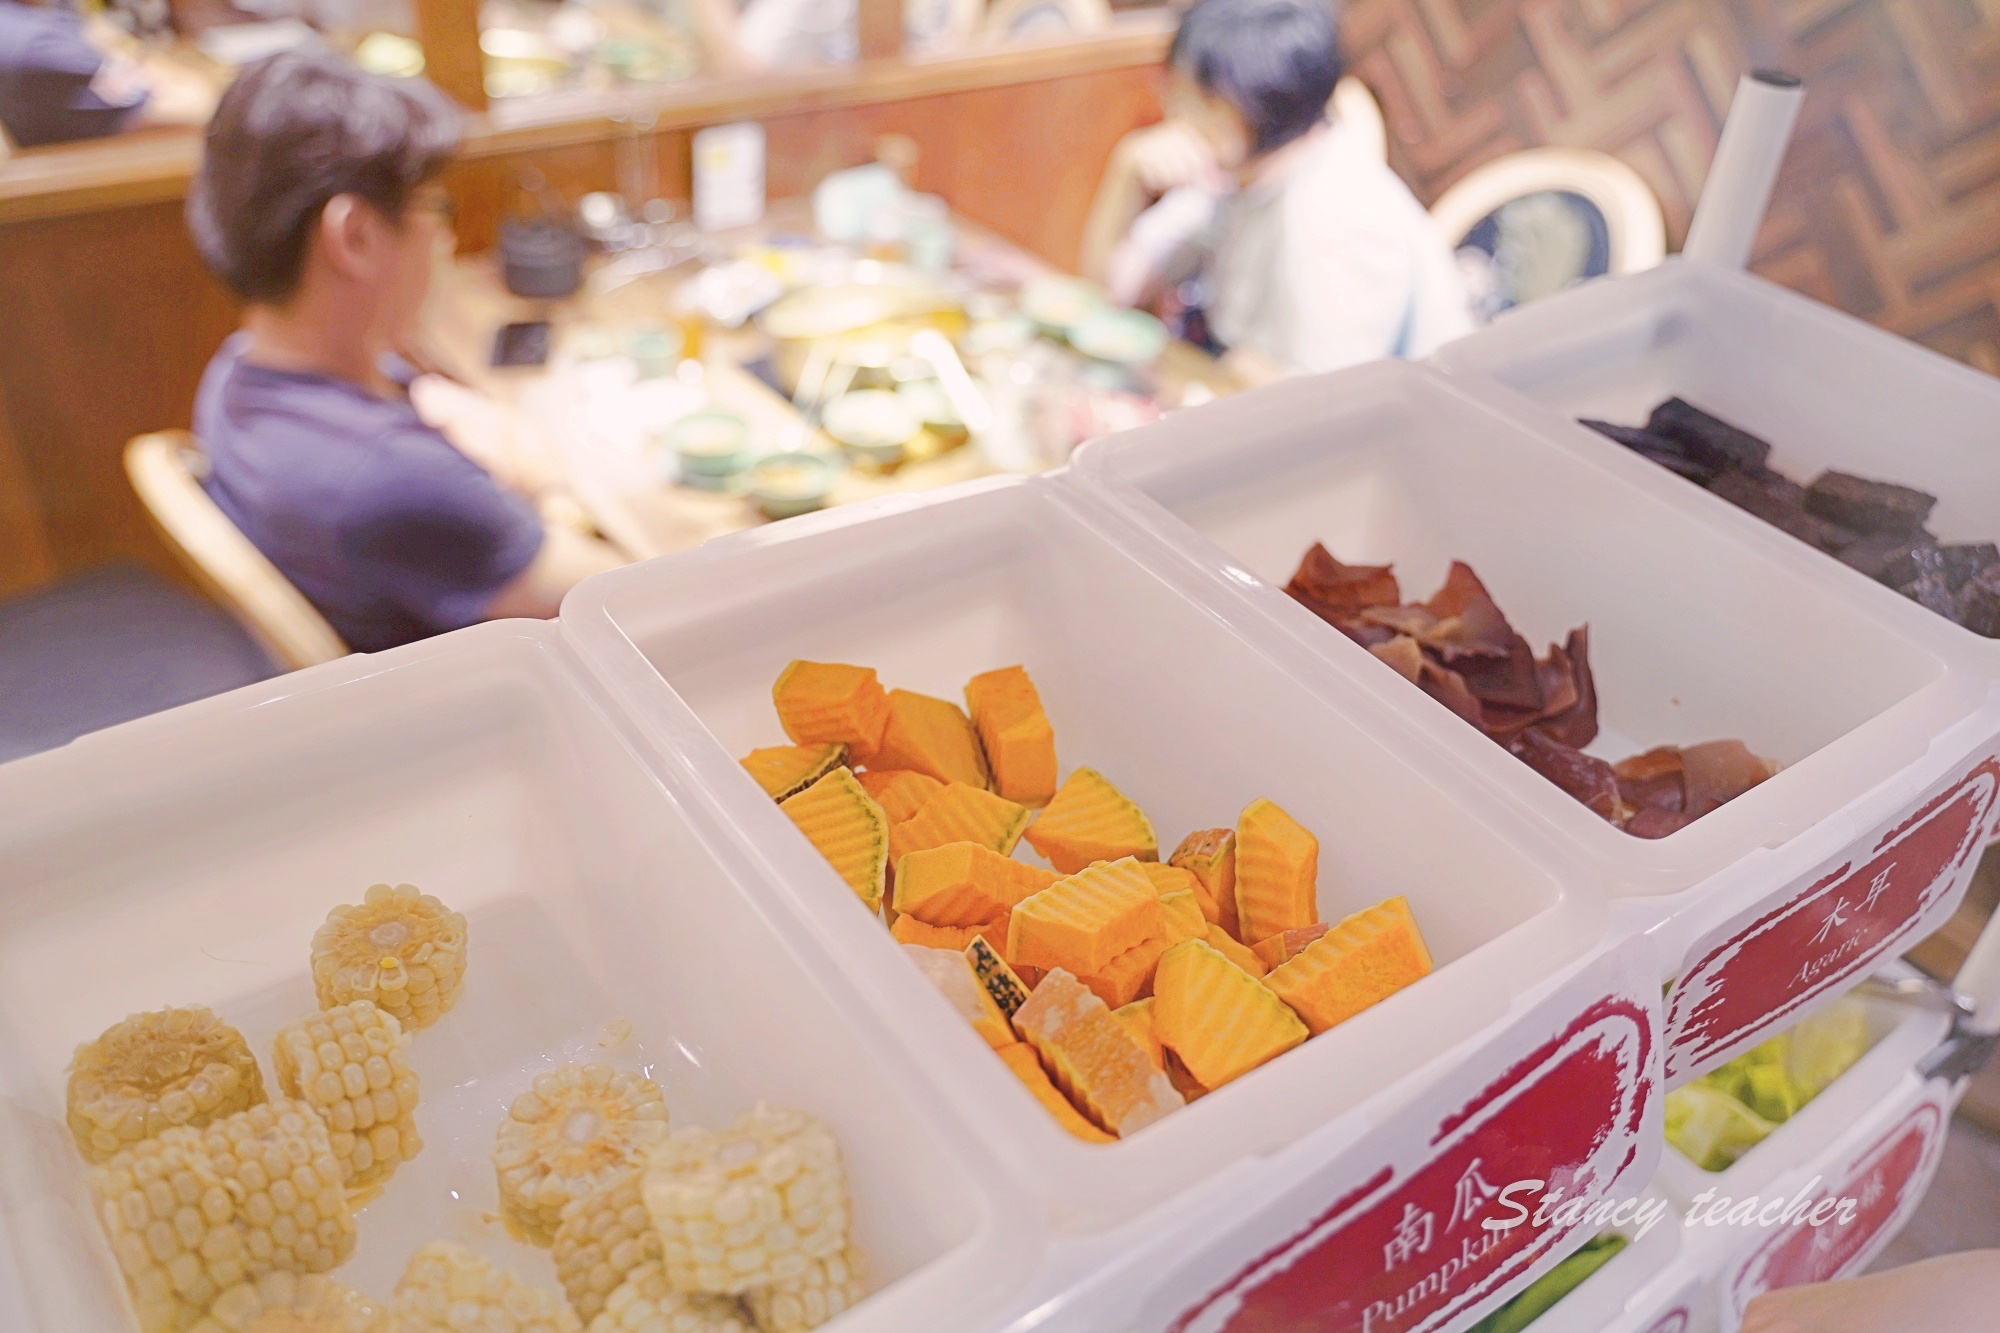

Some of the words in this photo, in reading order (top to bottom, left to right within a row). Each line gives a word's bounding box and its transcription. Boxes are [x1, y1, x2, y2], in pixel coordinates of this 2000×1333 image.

[1807, 861, 1897, 946] 木耳
[1786, 928, 1869, 989] Agaric
[1383, 1157, 1499, 1272] 南瓜
[1362, 1220, 1512, 1333] Pumpkin
